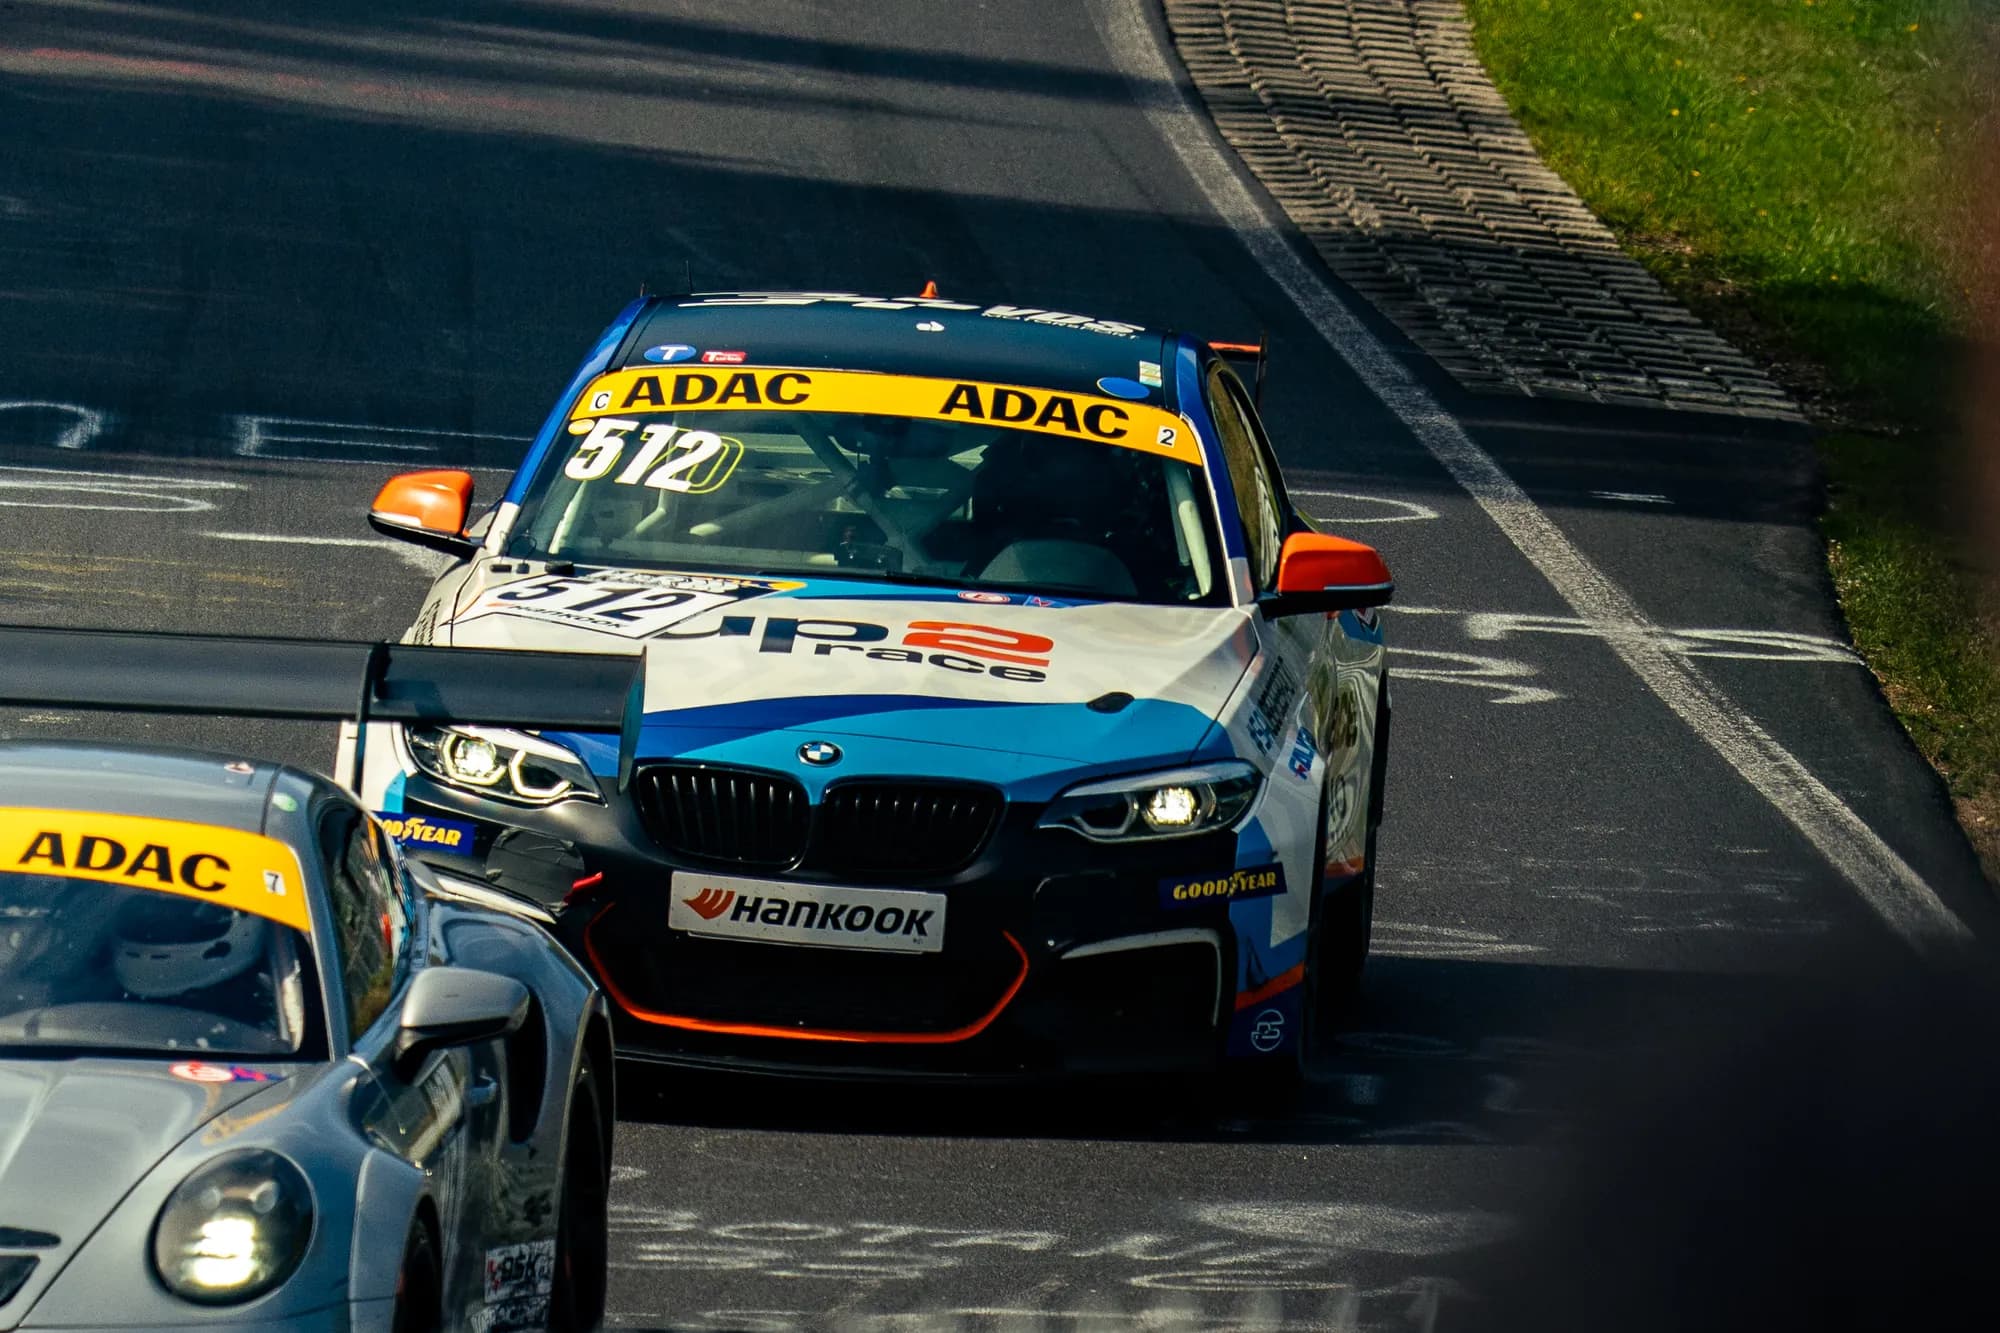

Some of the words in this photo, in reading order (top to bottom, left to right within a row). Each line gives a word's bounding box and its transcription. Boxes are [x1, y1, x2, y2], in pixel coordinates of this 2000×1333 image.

[595, 393, 609, 409] C
[621, 373, 812, 408] ADAC
[939, 383, 1129, 440] ADAC
[565, 417, 722, 493] 512
[1160, 428, 1174, 446] 2
[497, 578, 696, 621] 512
[815, 644, 1047, 683] race
[19, 831, 230, 892] ADAC
[267, 872, 279, 893] 7
[1173, 871, 1277, 900] GOODYEAR
